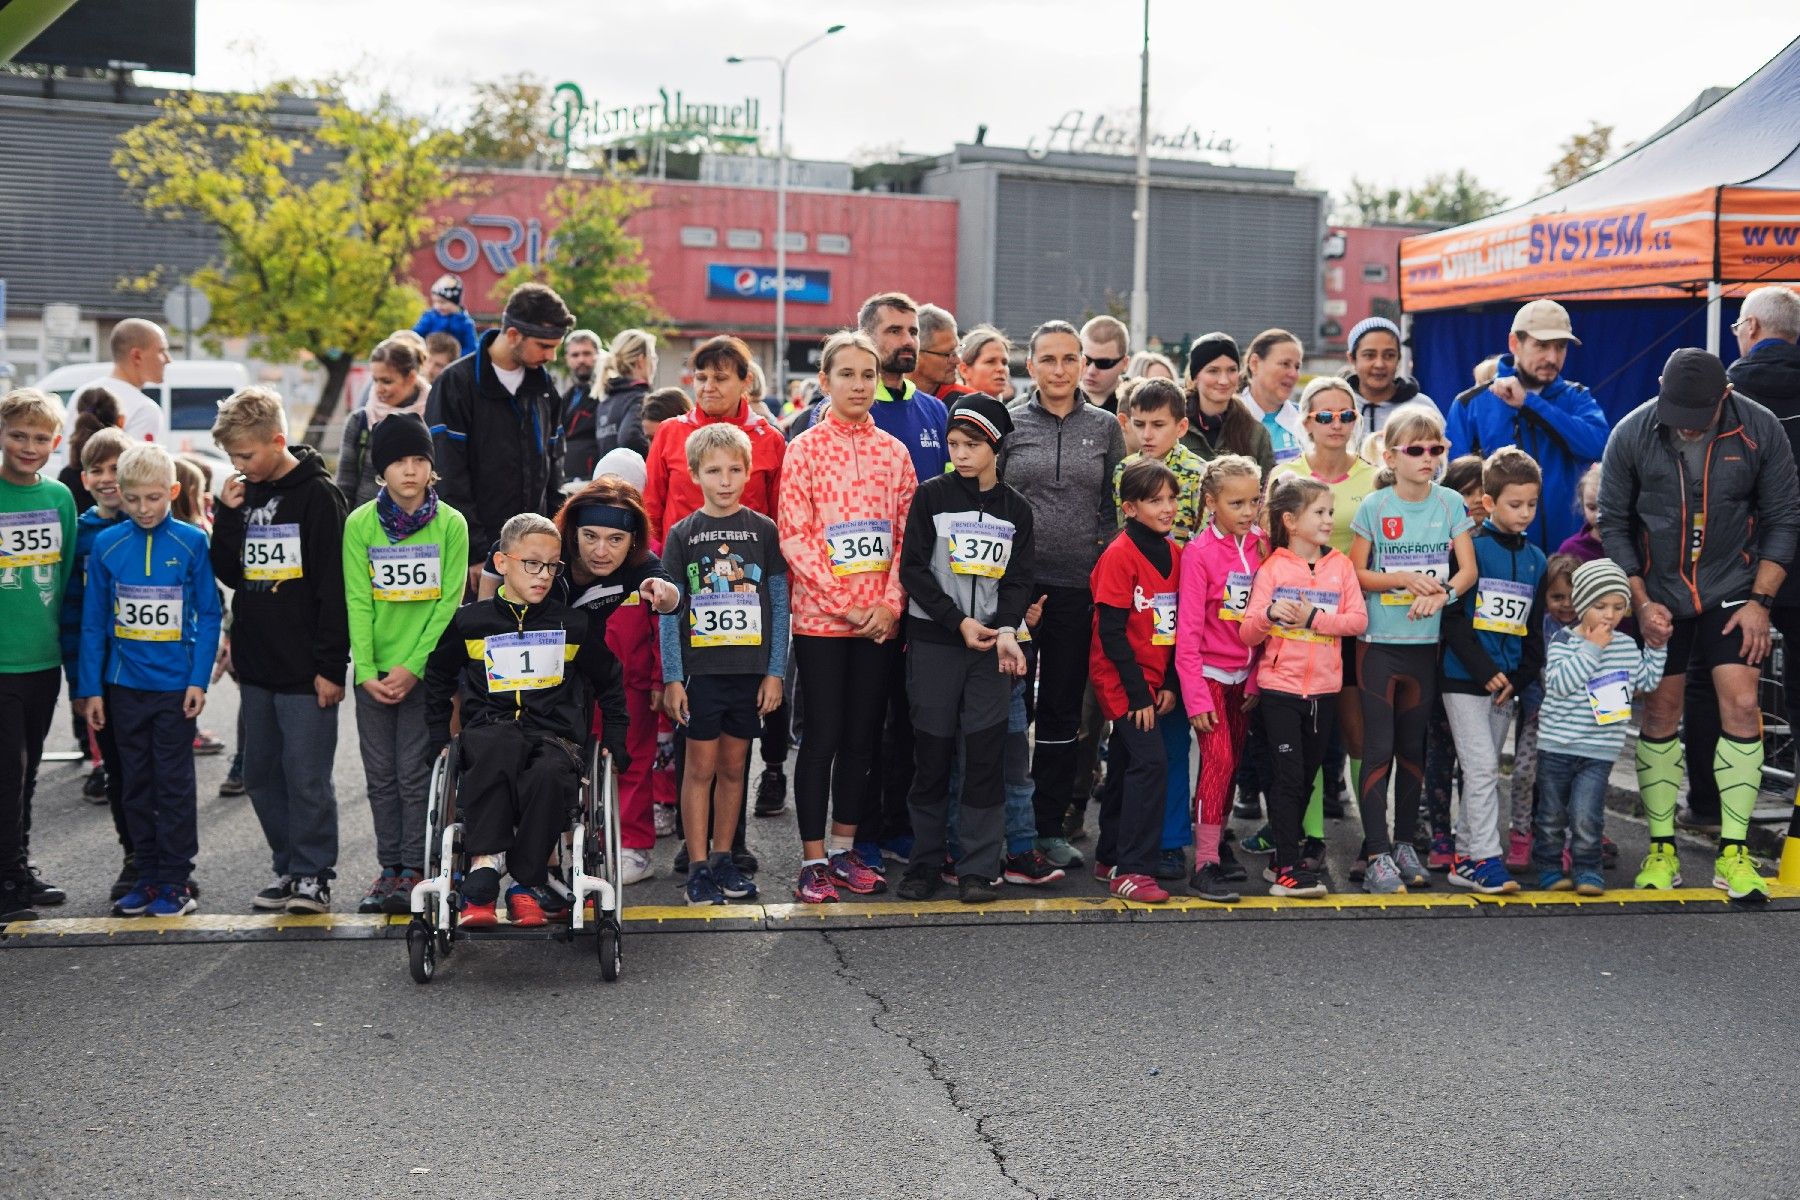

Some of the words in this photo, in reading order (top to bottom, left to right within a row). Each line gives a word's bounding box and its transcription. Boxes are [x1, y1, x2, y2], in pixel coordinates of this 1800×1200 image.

[549, 82, 658, 153] Pilsner
[660, 86, 759, 140] Urquell
[1026, 109, 1241, 160] Alexndria
[1529, 213, 1647, 264] SYSTEM
[11, 528, 52, 552] 355
[688, 530, 759, 546] MINECRAFT
[842, 536, 884, 559] 364
[247, 543, 285, 565] 354
[964, 538, 1004, 563] 370
[382, 563, 427, 586] 356
[126, 603, 169, 626] 366
[1490, 597, 1527, 620] 357
[704, 610, 748, 631] 363
[520, 650, 535, 673] 1
[1620, 685, 1631, 705] 1
